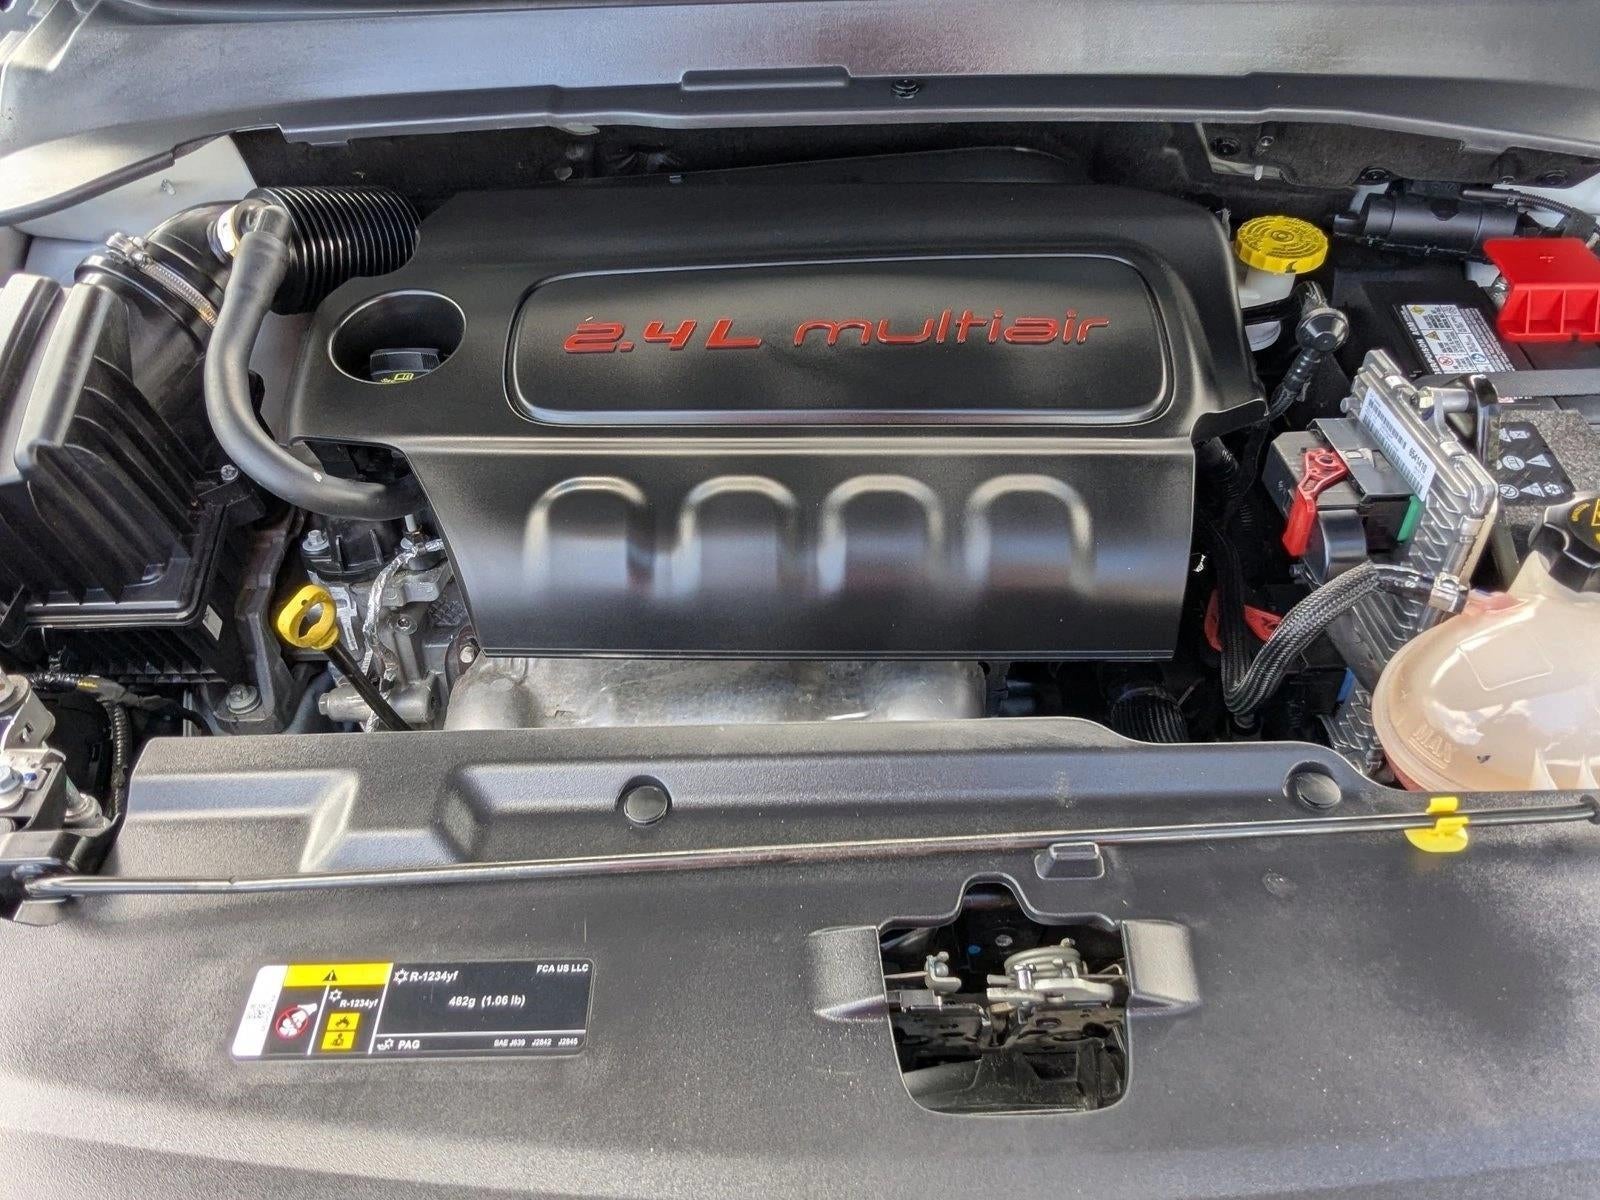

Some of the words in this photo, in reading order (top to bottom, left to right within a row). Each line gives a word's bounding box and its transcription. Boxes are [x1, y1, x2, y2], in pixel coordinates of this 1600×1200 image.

[792, 308, 1111, 347] multiair
[536, 964, 555, 974] FCA
[556, 964, 569, 973] US
[570, 963, 589, 973] LLC
[409, 970, 458, 983] R-1234yf
[340, 998, 378, 1010] R-1234yf
[480, 995, 508, 1009] (1.06
[510, 994, 526, 1008] lb)
[397, 1039, 420, 1050] PAG
[493, 1040, 509, 1048] SAE
